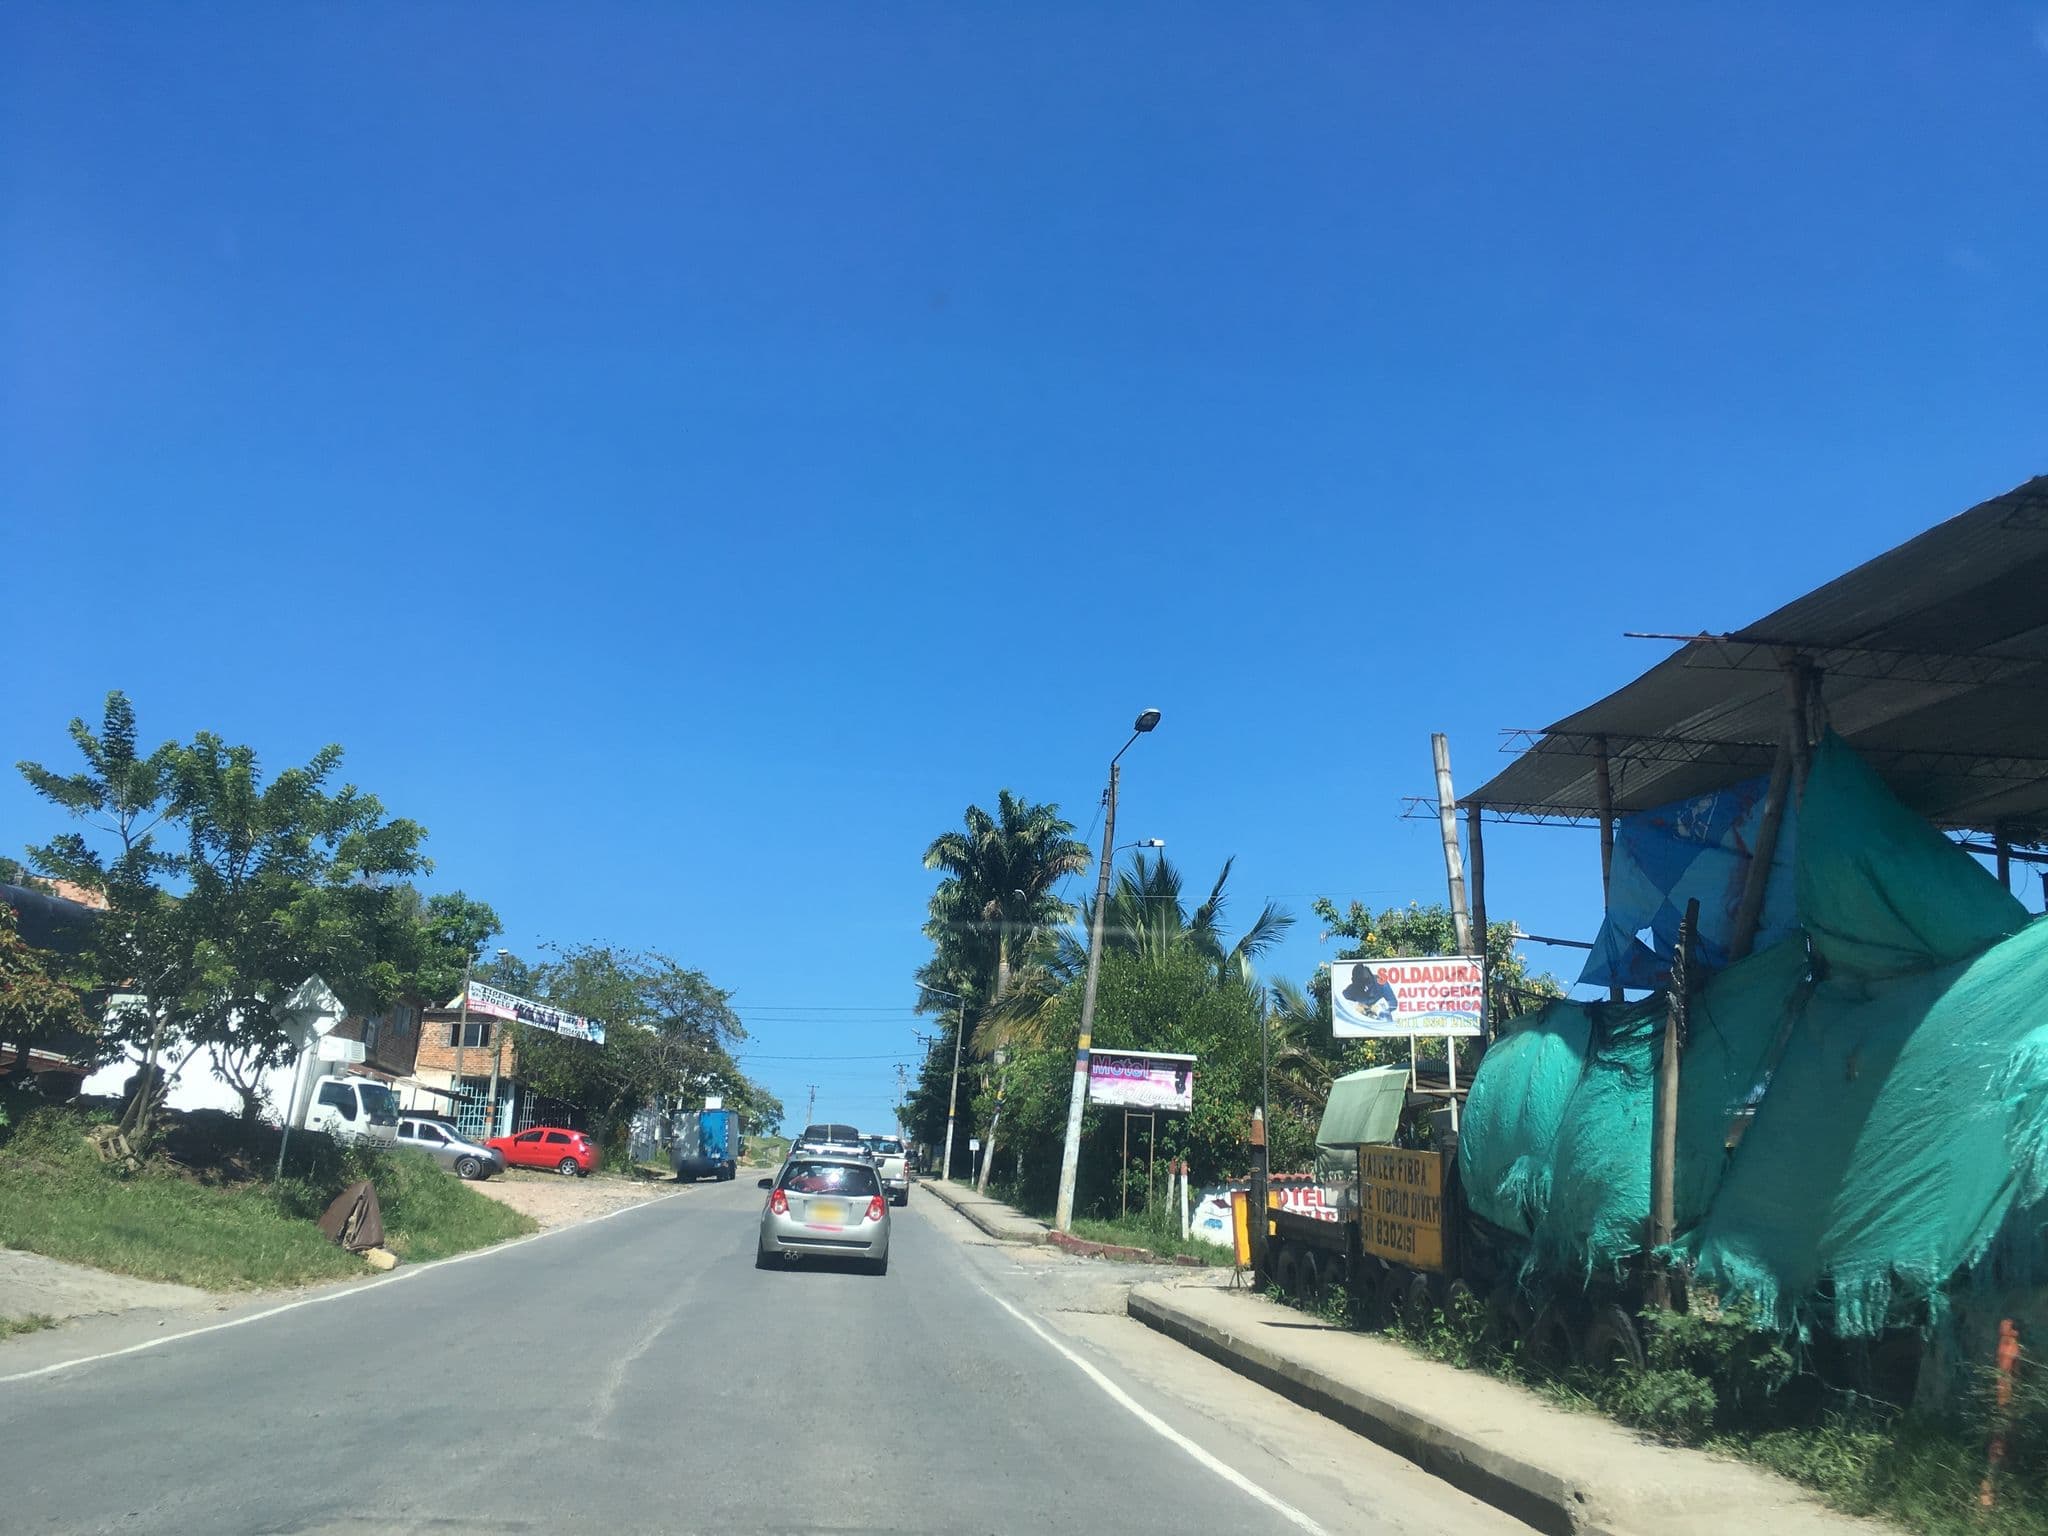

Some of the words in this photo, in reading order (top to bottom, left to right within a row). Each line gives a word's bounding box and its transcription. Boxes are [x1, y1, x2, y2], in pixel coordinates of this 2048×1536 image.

[1377, 965, 1481, 985] SOLDADURA
[1397, 984, 1482, 998] AUTÓGENA
[1398, 1000, 1482, 1012] ELECTRICA
[1092, 1055, 1150, 1079] Motel
[1398, 1157, 1427, 1186] FIBRA
